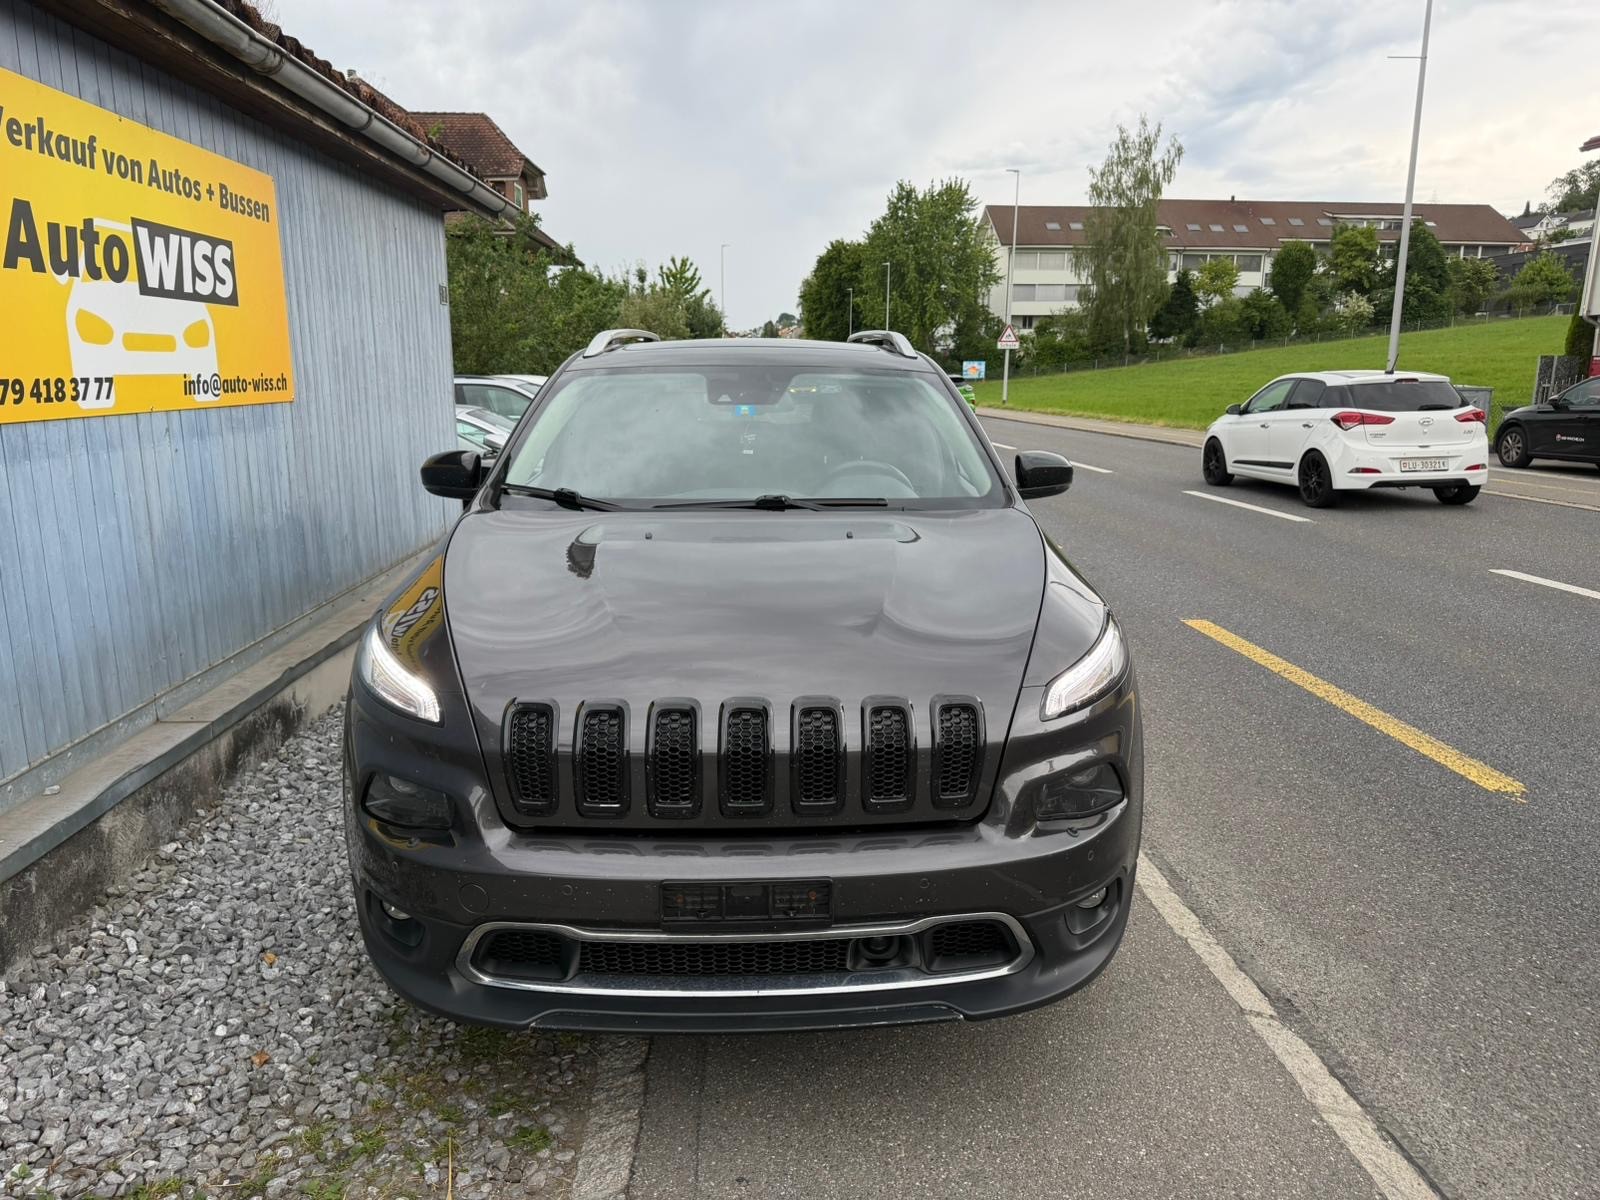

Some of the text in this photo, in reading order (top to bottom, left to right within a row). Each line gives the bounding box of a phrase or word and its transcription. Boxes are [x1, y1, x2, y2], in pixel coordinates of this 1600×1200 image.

[0, 106, 270, 223] erkauf von Autos + Bussen
[3, 197, 234, 299] Auto WISS
[0, 377, 114, 405] 79 418 37 77
[183, 372, 288, 397] info@auto-wiss.ch
